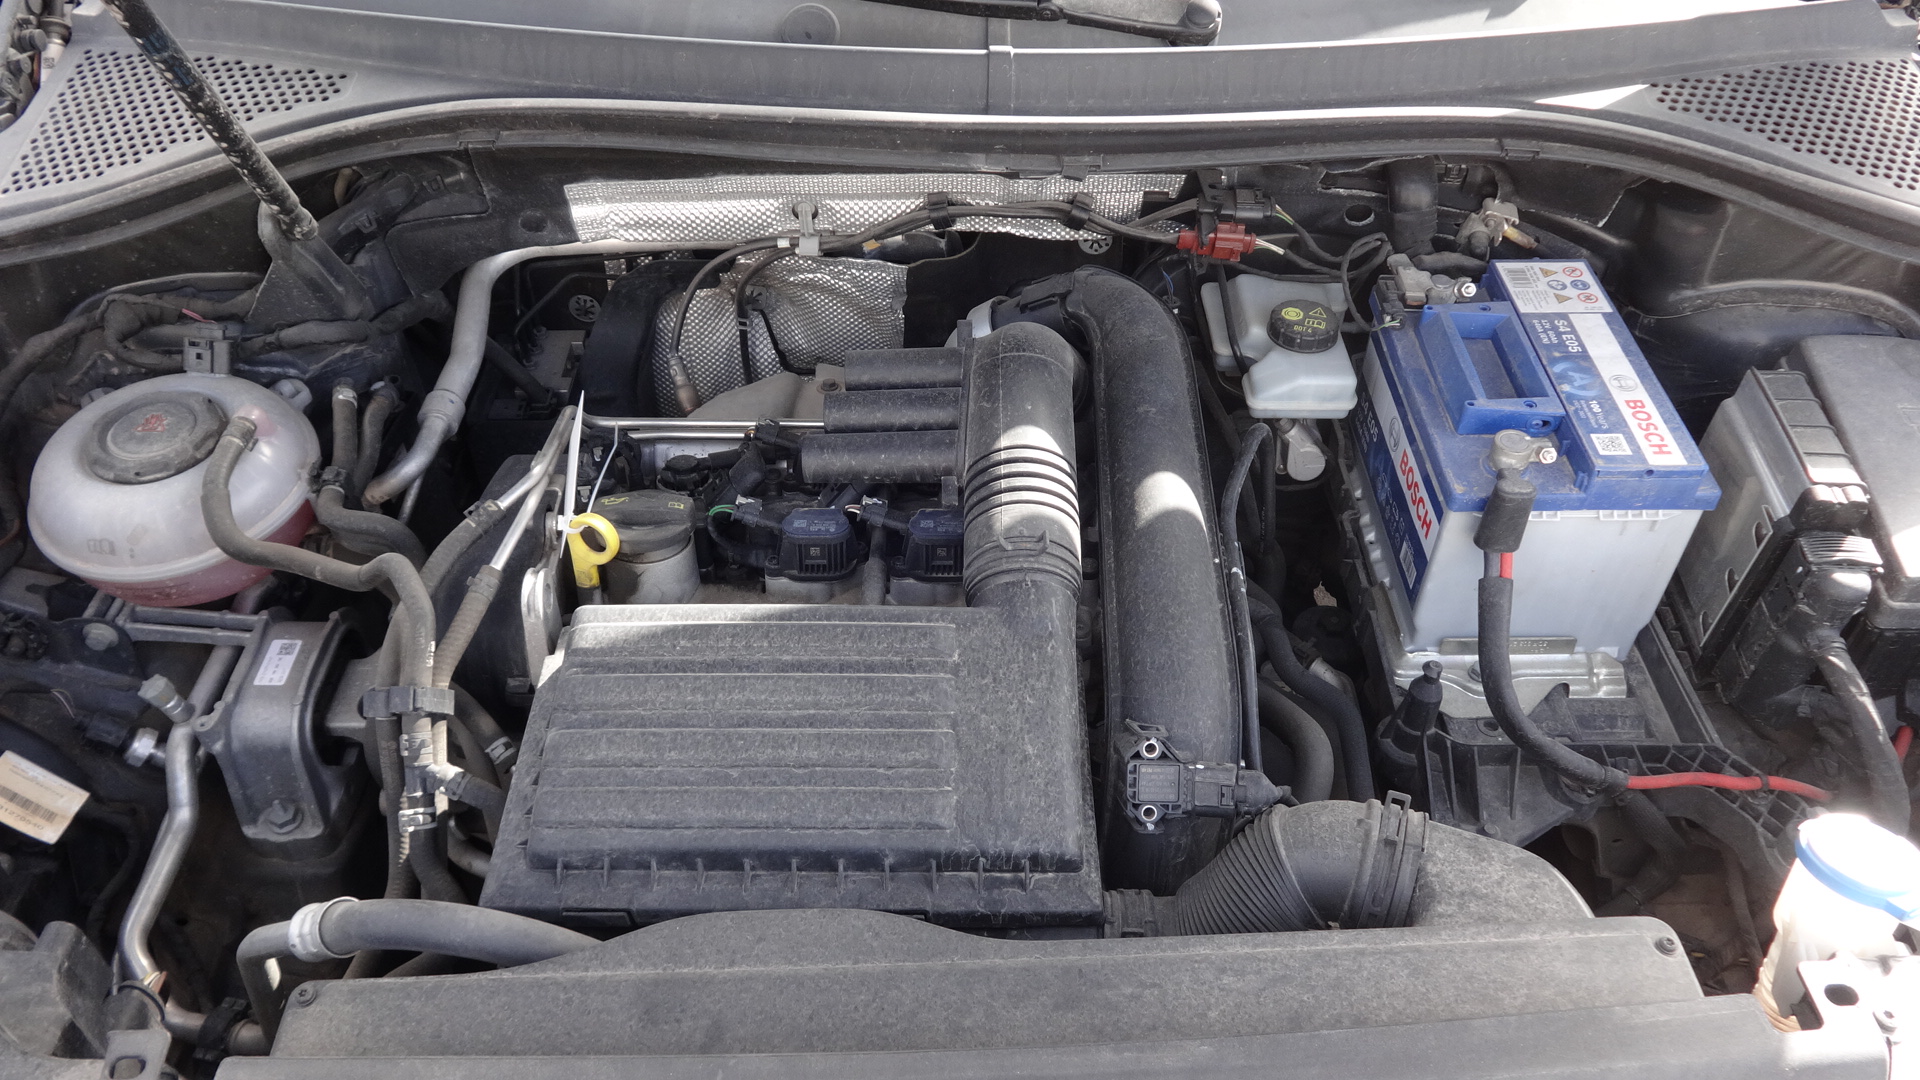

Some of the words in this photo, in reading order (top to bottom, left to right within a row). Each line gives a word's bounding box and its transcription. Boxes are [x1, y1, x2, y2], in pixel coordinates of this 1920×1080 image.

[1293, 324, 1307, 332] DOT
[1554, 319, 1571, 332] S4
[1562, 334, 1583, 353] E05
[1367, 410, 1378, 442] E05
[1588, 400, 1602, 412] 100
[1595, 410, 1609, 430] Years
[1624, 399, 1673, 455] BOSCH
[1399, 448, 1432, 540] BOSCH
